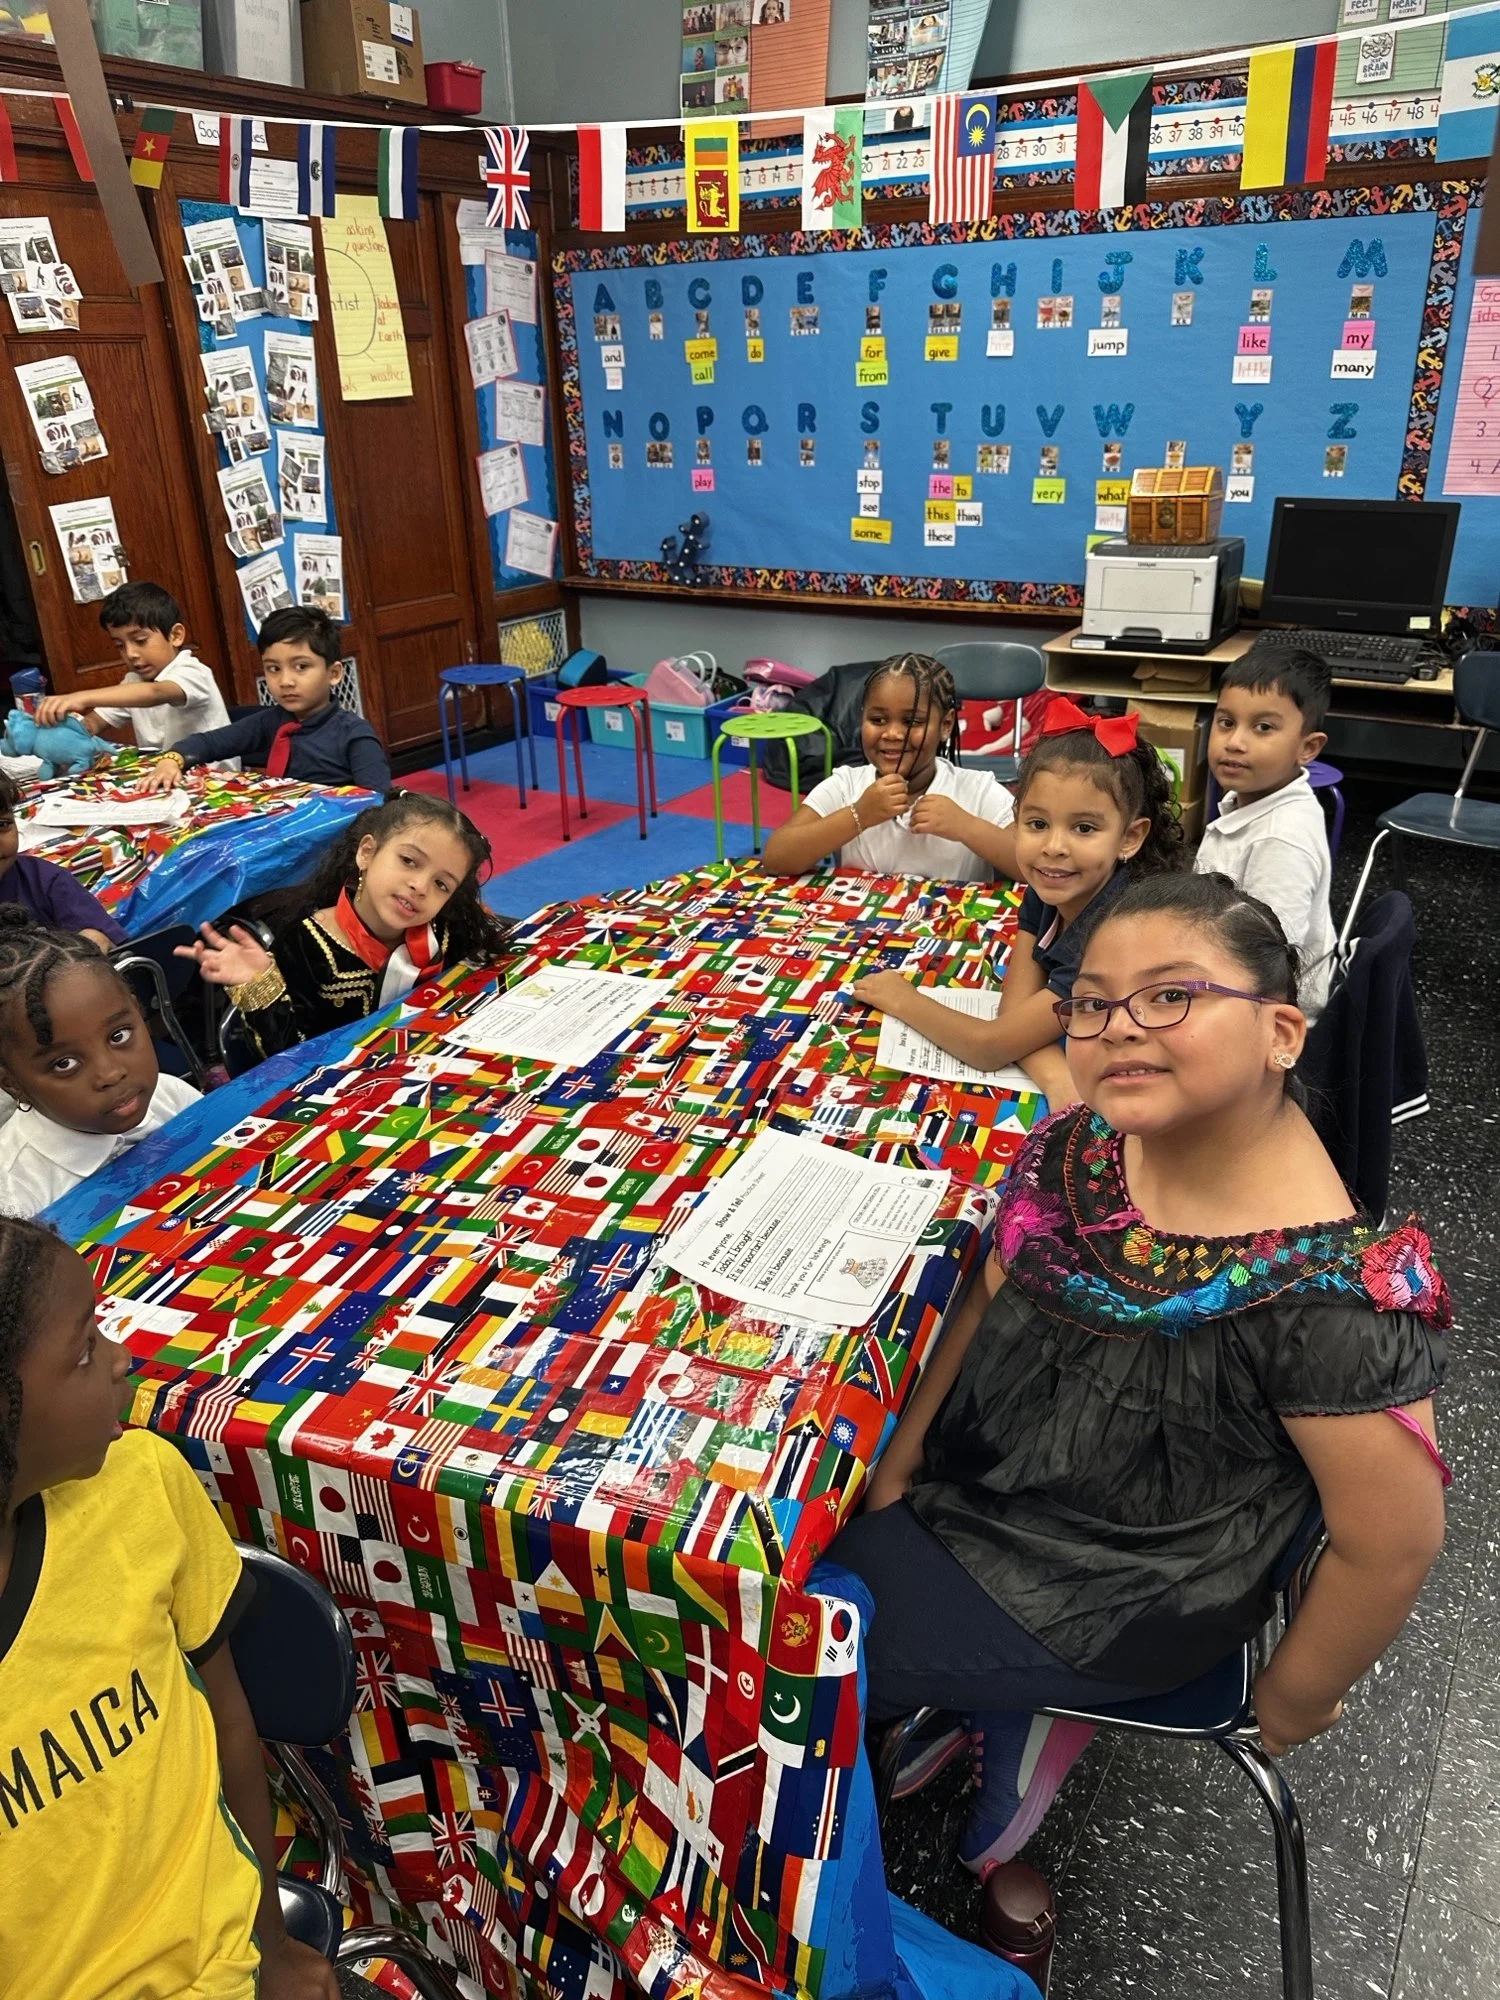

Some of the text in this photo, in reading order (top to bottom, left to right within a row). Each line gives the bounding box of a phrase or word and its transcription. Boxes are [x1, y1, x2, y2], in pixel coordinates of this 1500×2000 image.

[1363, 61, 1388, 73] BRAIN
[639, 186, 644, 197] 4
[651, 185, 657, 195] 5
[663, 184, 669, 194] 6
[675, 182, 681, 193] 7
[743, 176, 752, 187] 12
[758, 174, 766, 185] 13
[772, 174, 781, 183] 14
[786, 171, 795, 182] 15
[861, 162, 873, 173] 20
[882, 159, 891, 171] 21
[896, 158, 908, 169] 22
[912, 156, 925, 168] 23
[997, 147, 1010, 160] 28
[1015, 145, 1028, 158] 29
[1032, 144, 1047, 156] 30
[1056, 141, 1067, 154] 31
[1149, 131, 1163, 145] 36
[1168, 129, 1182, 143] 37
[1188, 127, 1204, 141] 38
[1208, 125, 1224, 139] 39
[1228, 123, 1245, 136] 40
[1340, 112, 1356, 126] 45
[1362, 110, 1378, 124] 46
[1384, 108, 1402, 122] 47
[1407, 106, 1424, 120] 48
[593, 238, 1389, 313] A B C D E F G H I J K L M
[377, 311, 386, 326] at
[1091, 338, 1125, 354] jump
[1242, 333, 1267, 348] like
[1346, 334, 1370, 349] my
[604, 351, 621, 362] and
[689, 349, 715, 360] come
[750, 345, 762, 359] do
[865, 345, 882, 358] for
[928, 349, 950, 360] give
[694, 367, 712, 381] call
[859, 368, 887, 382] from
[1333, 363, 1374, 376] many
[602, 401, 1359, 441] N O P Q R S T U V W Y Z
[695, 474, 712, 490] play
[859, 475, 880, 491] stop
[933, 480, 951, 494] the
[956, 484, 967, 496] to
[1036, 490, 1063, 502] very
[1098, 487, 1126, 501] what
[1230, 489, 1249, 499] you
[862, 504, 878, 513] see
[927, 507, 950, 520] this
[957, 509, 980, 525] thing
[855, 530, 883, 540] some
[928, 529, 953, 542] these
[728, 1204, 736, 1213] &
[731, 1197, 743, 1209] Tell
[715, 1210, 732, 1228] Show
[698, 1233, 734, 1269] Hi everyone,
[712, 1256, 734, 1277] Today
[733, 1230, 753, 1257] brought
[726, 1269, 738, 1282] It
[739, 1237, 764, 1270] important
[761, 1218, 781, 1240] because
[760, 1275, 772, 1290] like
[773, 1247, 793, 1271] because
[802, 1261, 813, 1271] for
[798, 1270, 808, 1282] you
[781, 1281, 799, 1299] Thank
